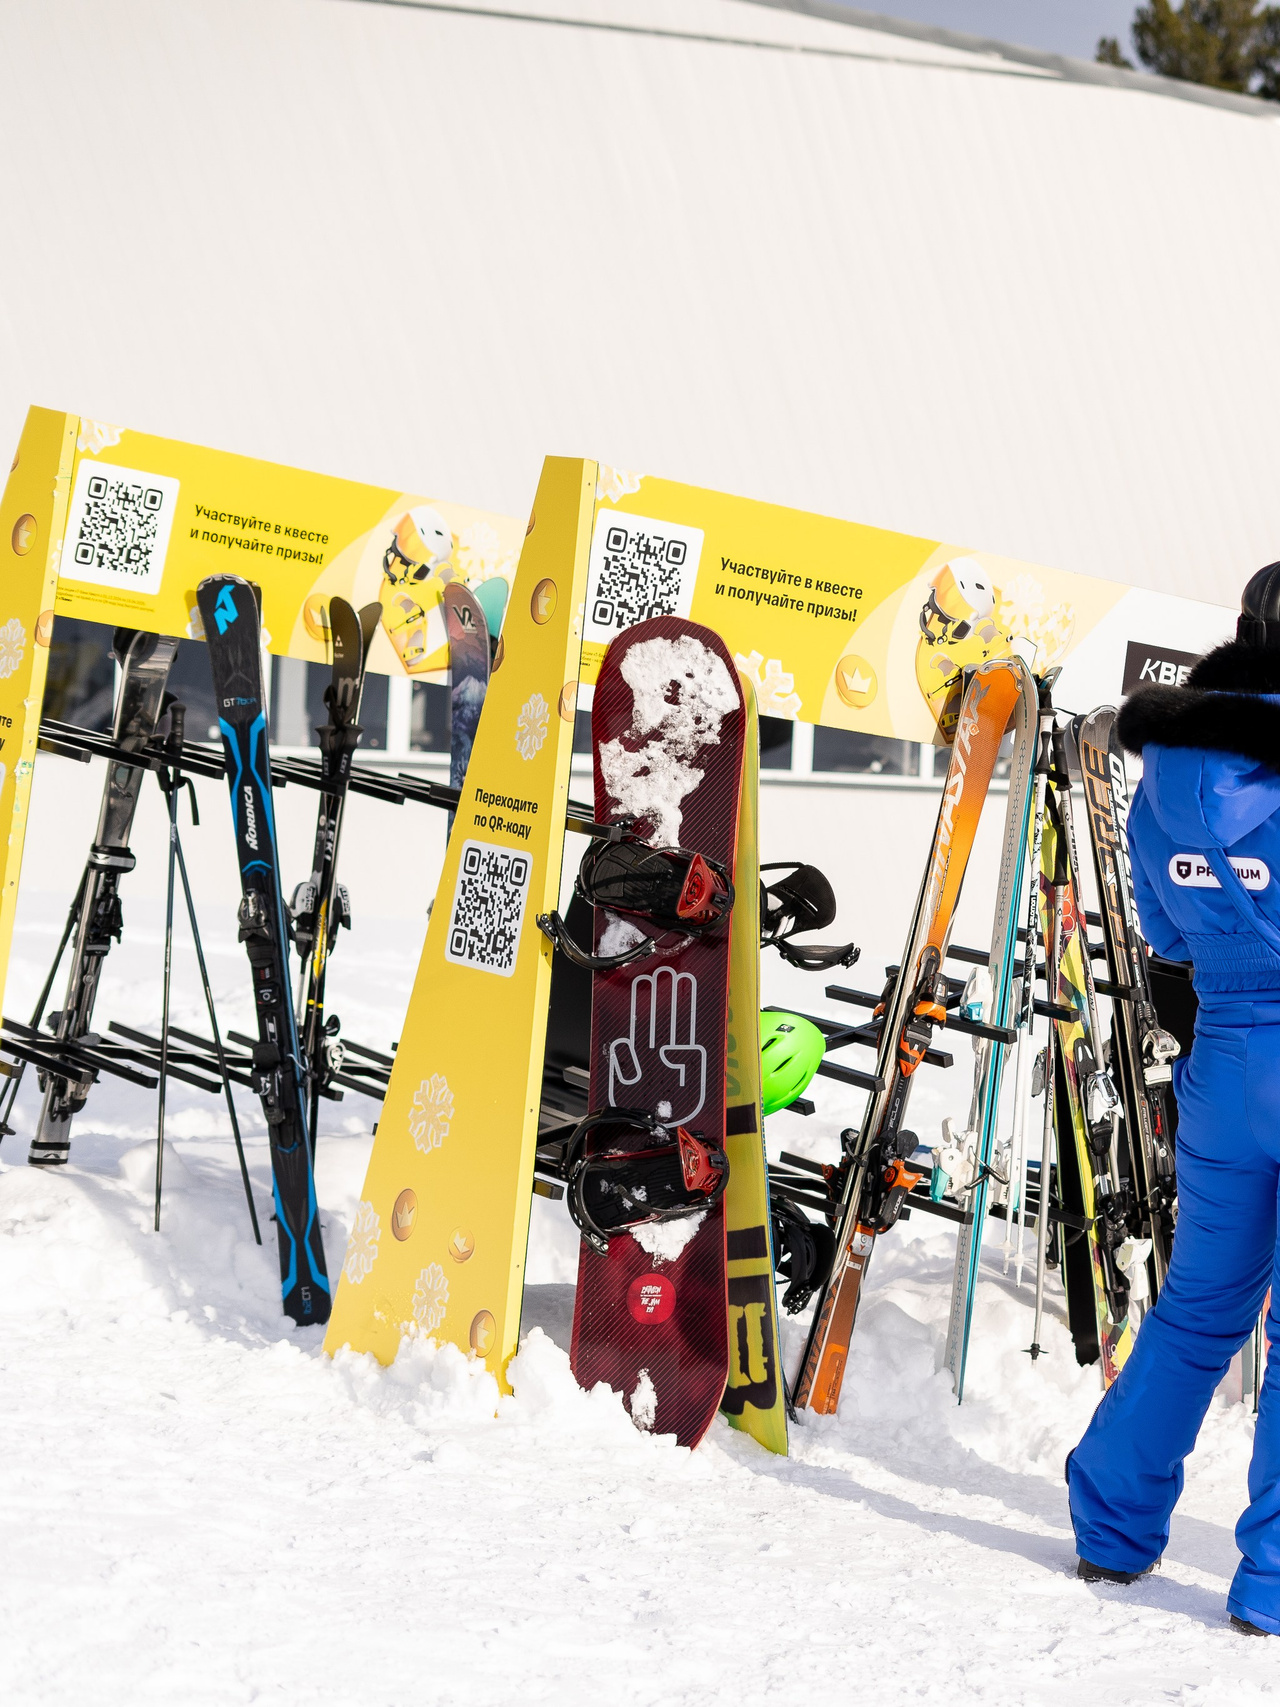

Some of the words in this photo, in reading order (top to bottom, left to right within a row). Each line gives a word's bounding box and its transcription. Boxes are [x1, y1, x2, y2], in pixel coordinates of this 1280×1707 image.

[195, 504, 271, 532] Участвуйте
[274, 524, 281, 534] в
[284, 526, 329, 544] квесте
[190, 528, 199, 539] и
[202, 531, 273, 554] получайте
[276, 546, 324, 564] призы!
[720, 556, 802, 586] Участвуйте
[804, 577, 813, 589] в
[815, 579, 863, 599] квесте
[715, 583, 725, 595] и
[727, 586, 804, 611] получайте
[806, 602, 857, 622] призы!
[1138, 658, 1193, 687] КВЕ
[243, 785, 259, 851] NORDICA
[475, 788, 538, 814] Переходите
[324, 818, 336, 861] LEKI
[473, 814, 487, 827] по
[488, 815, 532, 840] QR-коду
[1196, 865, 1261, 880] PRIUM
[891, 1194, 904, 1215] LOOK
